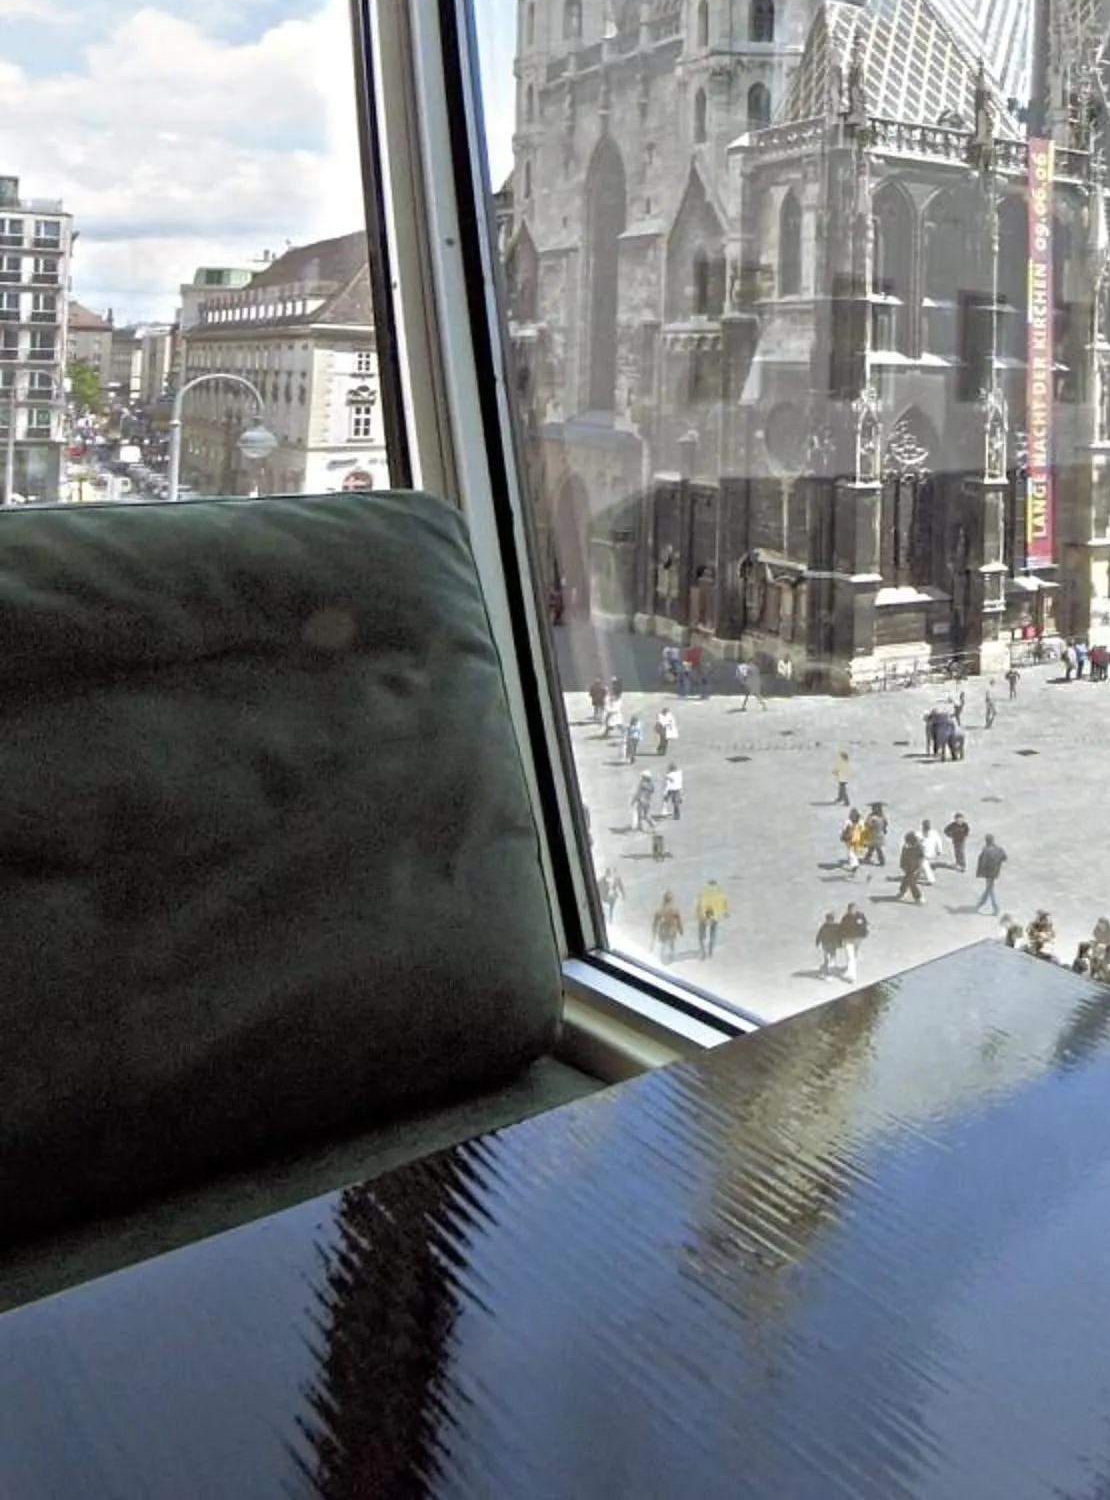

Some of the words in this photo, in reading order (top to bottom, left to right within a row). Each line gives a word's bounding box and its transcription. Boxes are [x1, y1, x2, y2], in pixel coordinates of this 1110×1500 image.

[1032, 263, 1048, 350] KIRCHEN
[1031, 357, 1048, 394] DER
[1030, 400, 1048, 467] NACHT
[1030, 473, 1048, 538] LANGE
